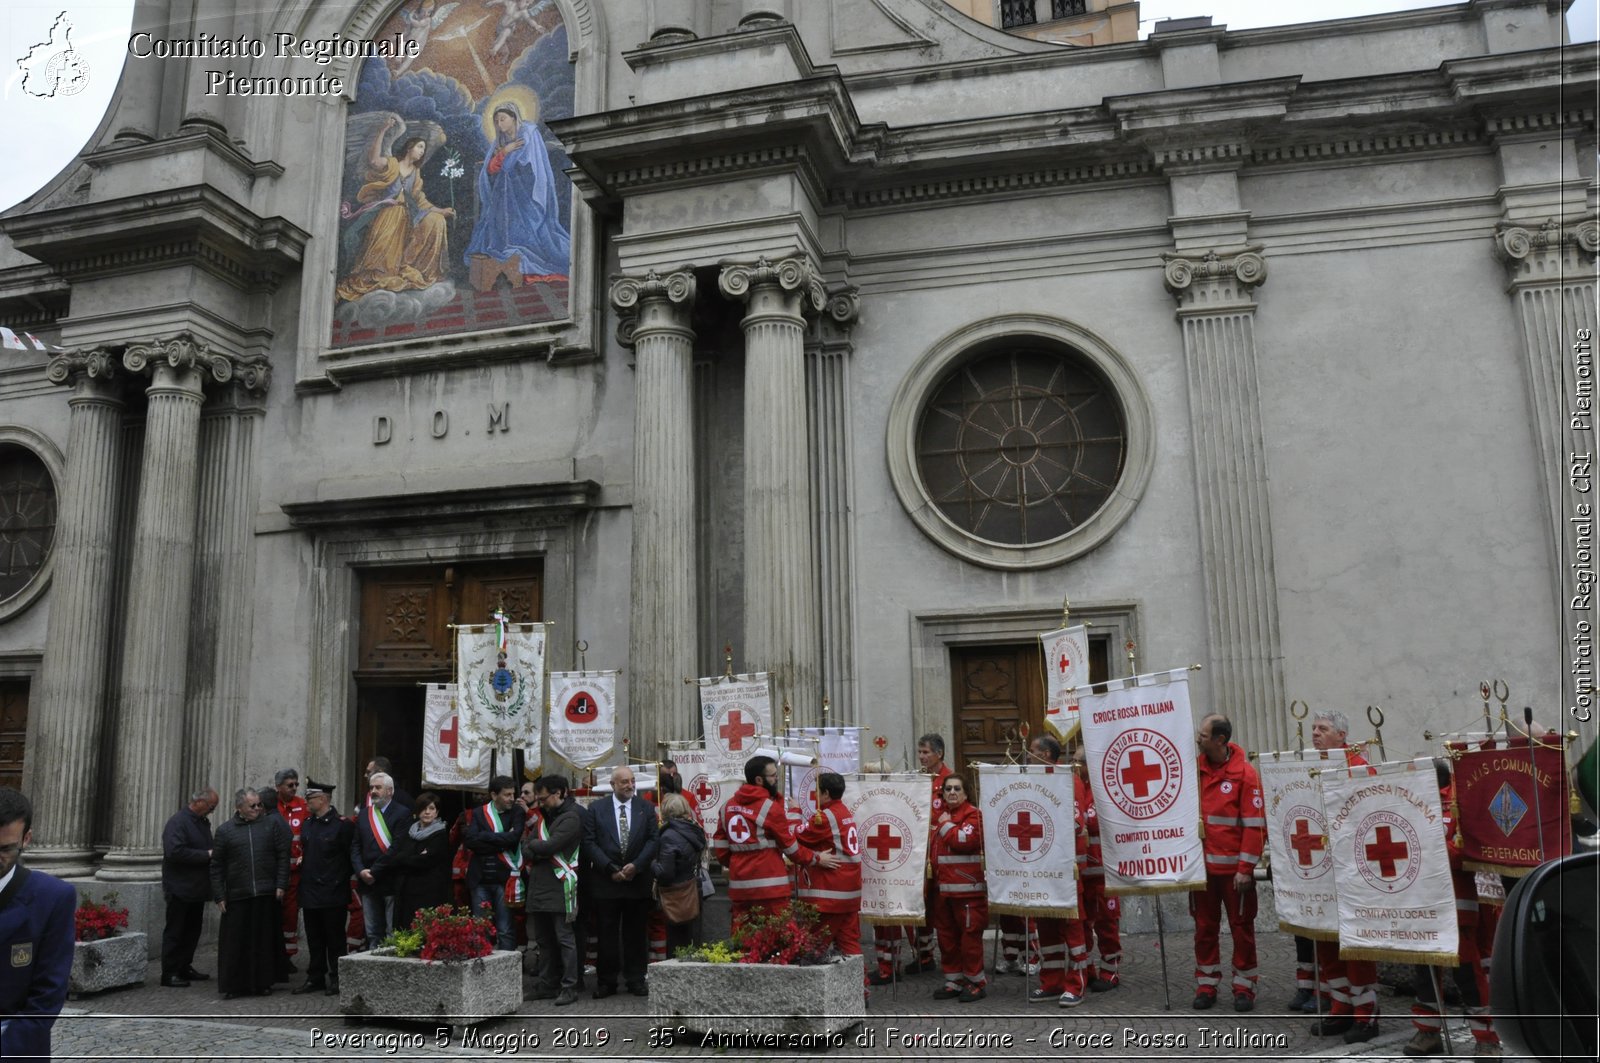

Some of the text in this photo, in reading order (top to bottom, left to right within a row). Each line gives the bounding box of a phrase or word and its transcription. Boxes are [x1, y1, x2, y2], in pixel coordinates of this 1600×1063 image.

[1093, 700, 1174, 724] CROCE ROSSA ITALIANA
[691, 754, 705, 763] ROSS
[1106, 732, 1180, 787] CONVENZIONE DI GINEVRA
[1285, 780, 1312, 793] ROSSA
[989, 781, 1061, 808] CROCE ROSSA ITALIANA
[868, 787, 896, 797] ROSSA
[897, 791, 922, 821] ITALIANA
[1118, 793, 1174, 817] 22 AGOSTO 1864
[1332, 785, 1437, 831] CROCE ROSSA ITALIANA
[1115, 827, 1184, 843] COMITATO LOCALE
[1142, 844, 1151, 854] di
[1355, 827, 1374, 882] CONVENZIONE
[1368, 812, 1399, 825] GINEVRA
[1399, 819, 1409, 831] 22
[1407, 829, 1420, 866] AGOSTO
[1118, 855, 1187, 877] MONDOVI'
[995, 869, 1063, 878] COMITATO LOCALE
[889, 878, 915, 886] LOCALE
[879, 889, 887, 897] DI
[1009, 891, 1049, 900] DRONERO
[1309, 893, 1337, 903] LOCA
[863, 901, 903, 909] BUSCA
[1355, 909, 1437, 919] COMITATO LOCALE
[1356, 929, 1438, 940] LIMONE PIEMONTE
